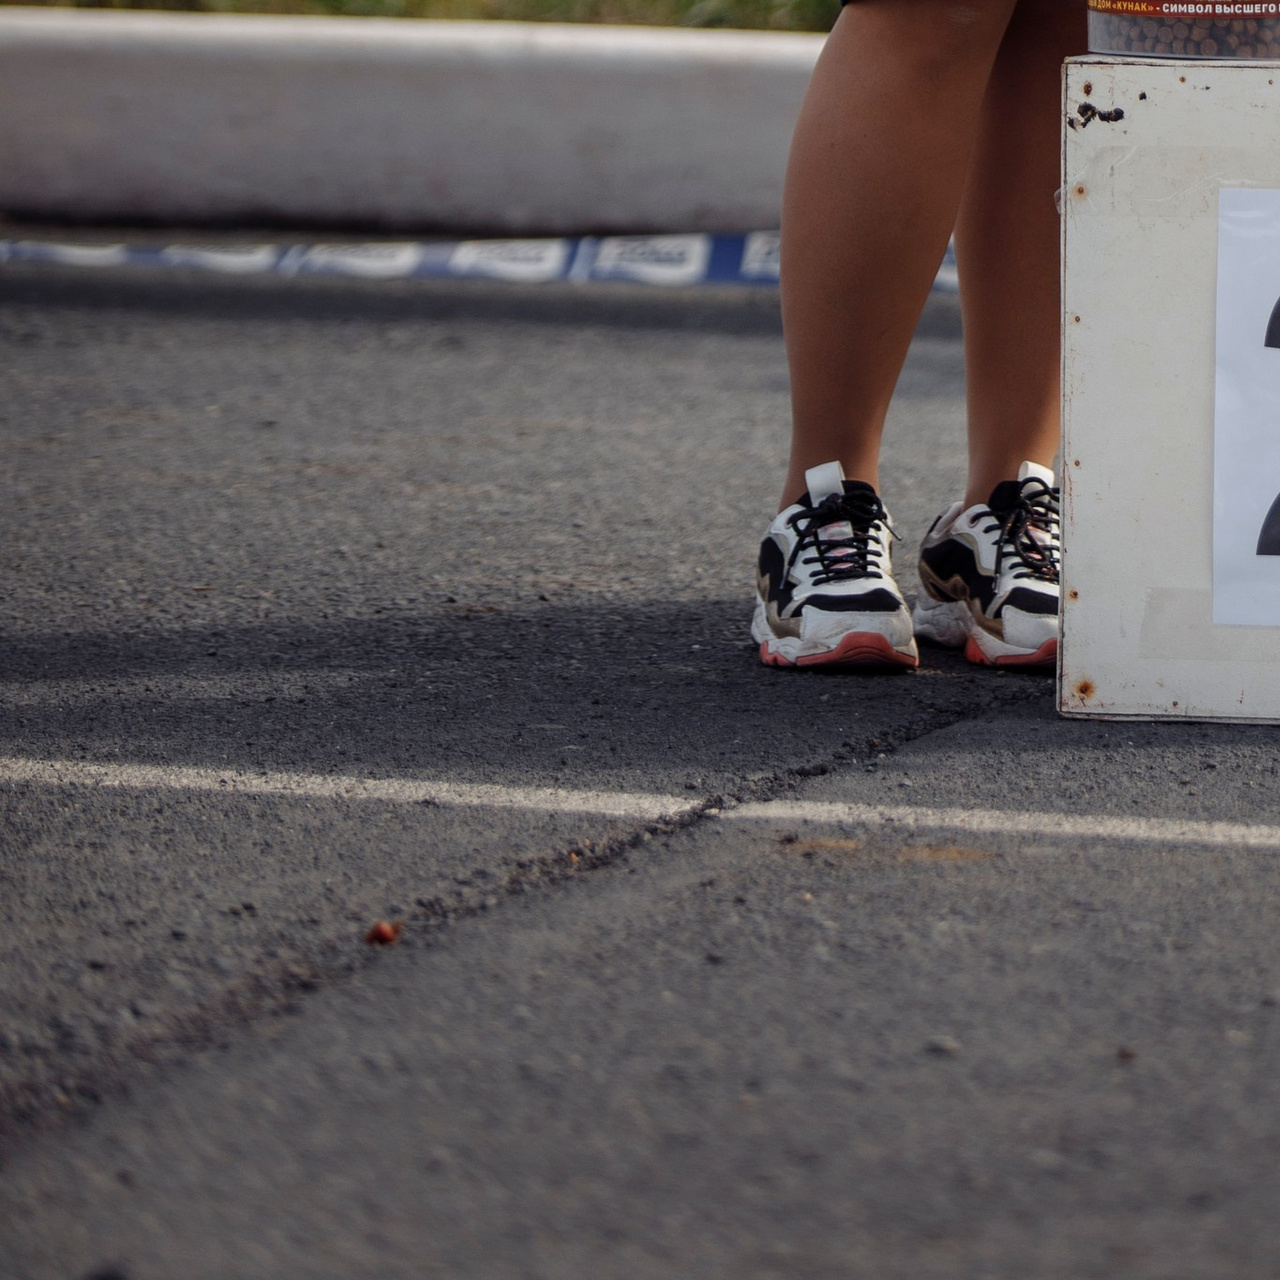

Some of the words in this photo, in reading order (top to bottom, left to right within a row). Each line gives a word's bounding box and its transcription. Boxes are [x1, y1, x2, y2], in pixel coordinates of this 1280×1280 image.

[1112, 0, 1154, 12] «КУНАК»
[1162, 3, 1213, 13] СИМВОЛ
[1215, 3, 1276, 14] ВЫСШЕГО
